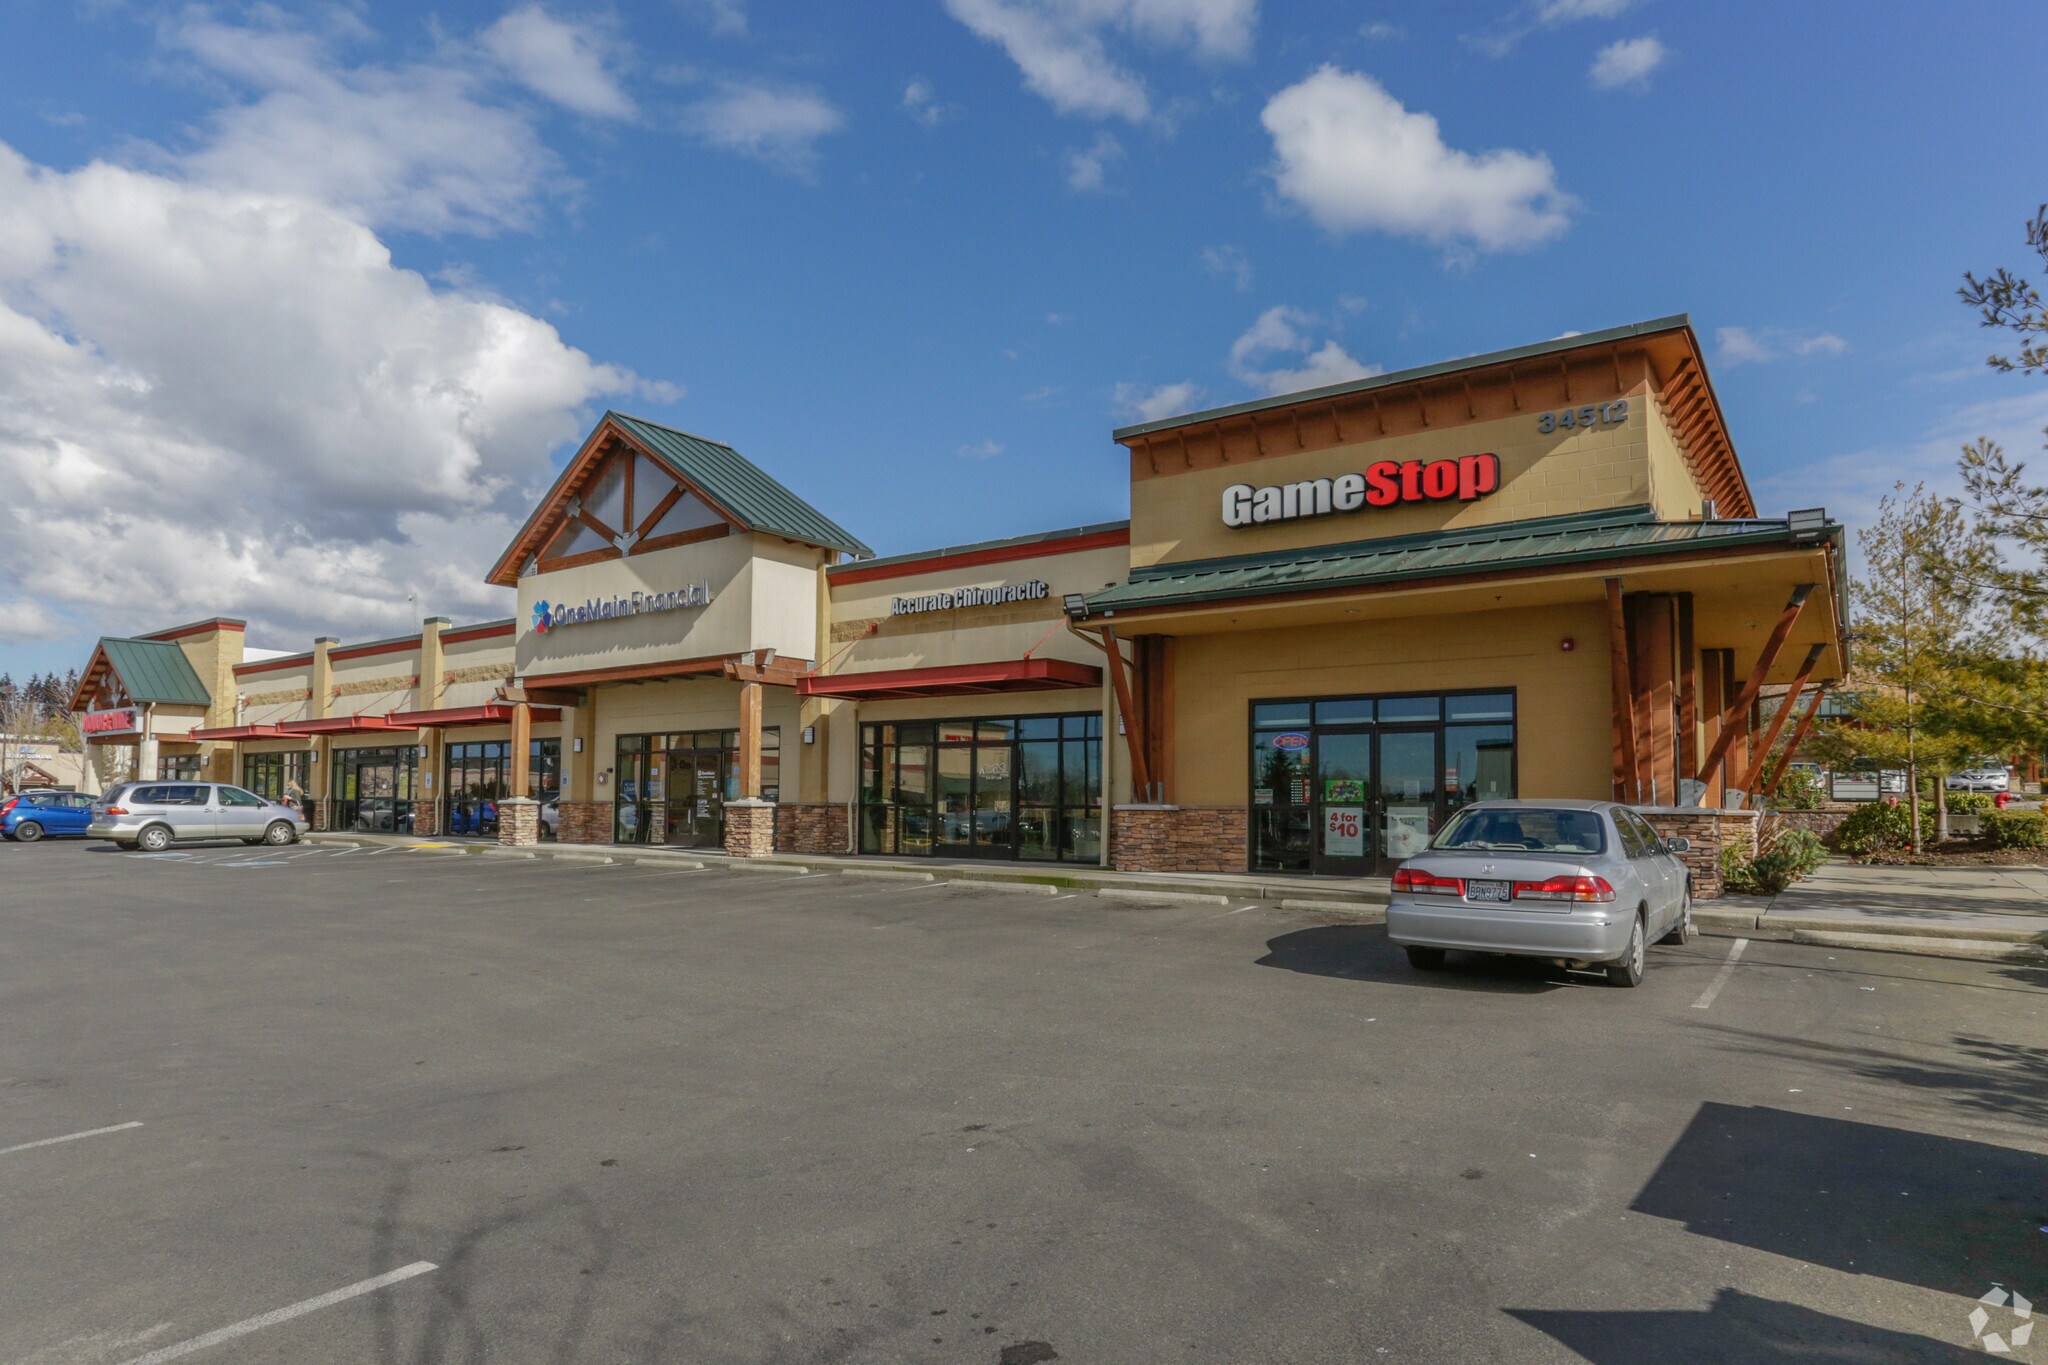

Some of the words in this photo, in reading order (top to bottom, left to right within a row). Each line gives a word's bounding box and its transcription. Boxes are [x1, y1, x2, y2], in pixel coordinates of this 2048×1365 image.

[1537, 400, 1629, 433] 34512
[1222, 453, 1499, 529] GameStop
[891, 592, 952, 616] Accurate
[954, 580, 1048, 608] Chiropractic
[1274, 735, 1308, 747] OPEN
[1330, 812, 1339, 822] 4
[1341, 812, 1358, 822] for
[1329, 823, 1359, 838] $10
